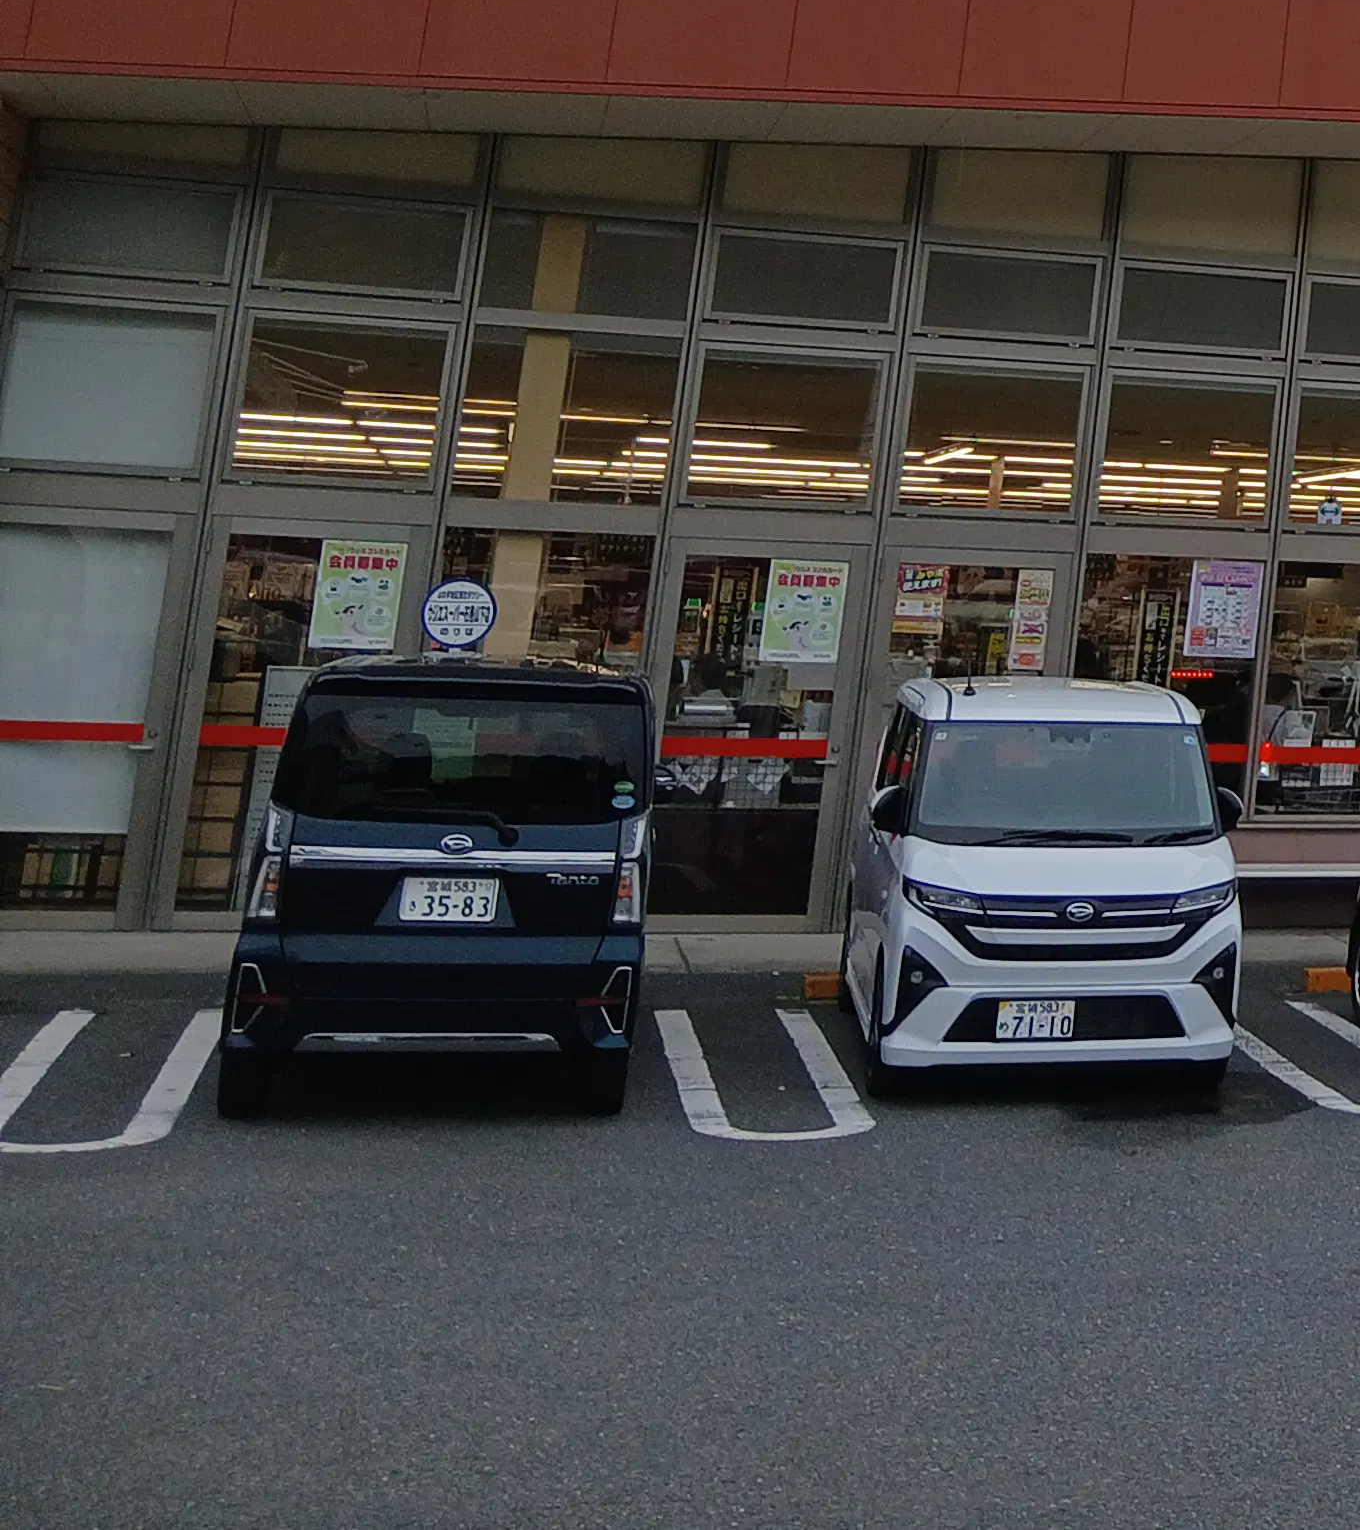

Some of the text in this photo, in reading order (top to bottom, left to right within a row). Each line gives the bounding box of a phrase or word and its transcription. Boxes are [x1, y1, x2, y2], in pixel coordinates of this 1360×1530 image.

[328, 555, 399, 571] 会員募集中
[778, 573, 840, 588] 会員募集中
[421, 895, 490, 917] 35-83
[1012, 1015, 1072, 1037] 71-10
